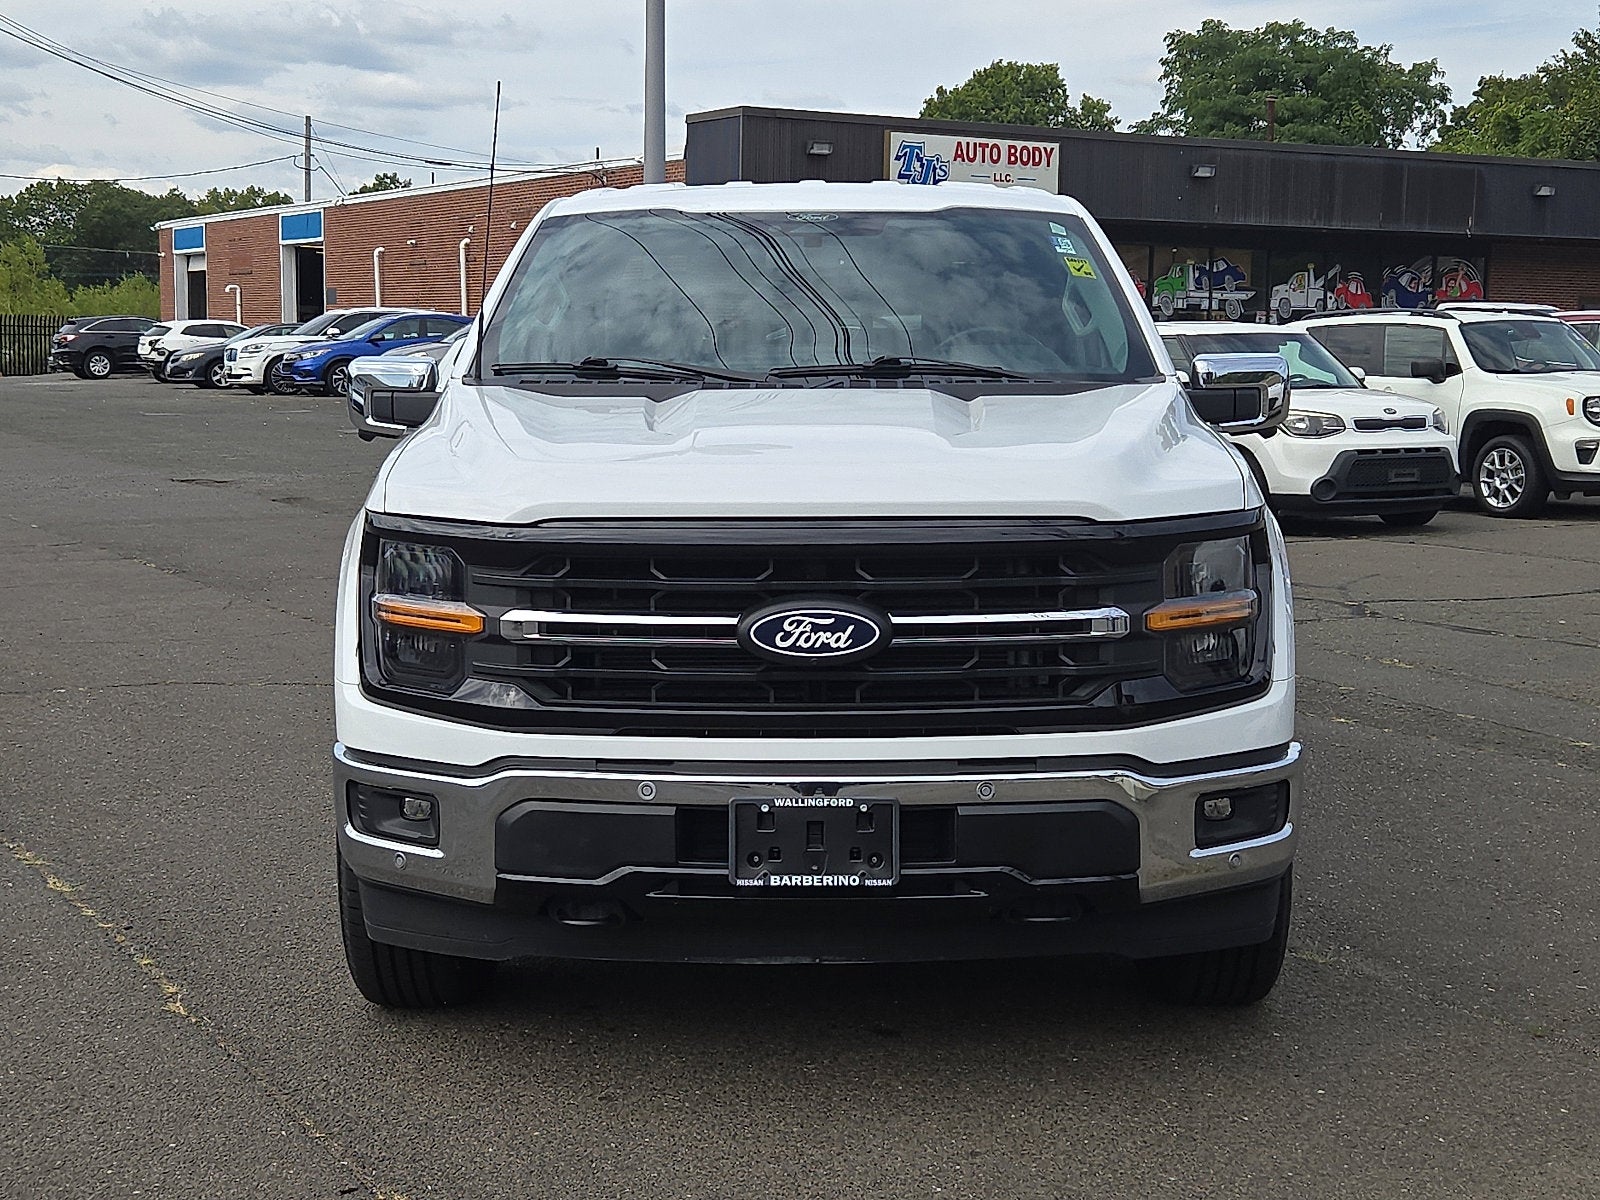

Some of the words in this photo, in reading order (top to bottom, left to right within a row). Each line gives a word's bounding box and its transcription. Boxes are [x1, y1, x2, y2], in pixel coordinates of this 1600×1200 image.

[953, 141, 1001, 164] AUTO
[1007, 145, 1055, 168] BODY
[775, 616, 855, 648] Ford
[774, 798, 854, 807] WALLINGFORD
[736, 878, 764, 886] NISSAN
[770, 875, 860, 886] BARBERINO
[864, 878, 893, 886] NISSAN
